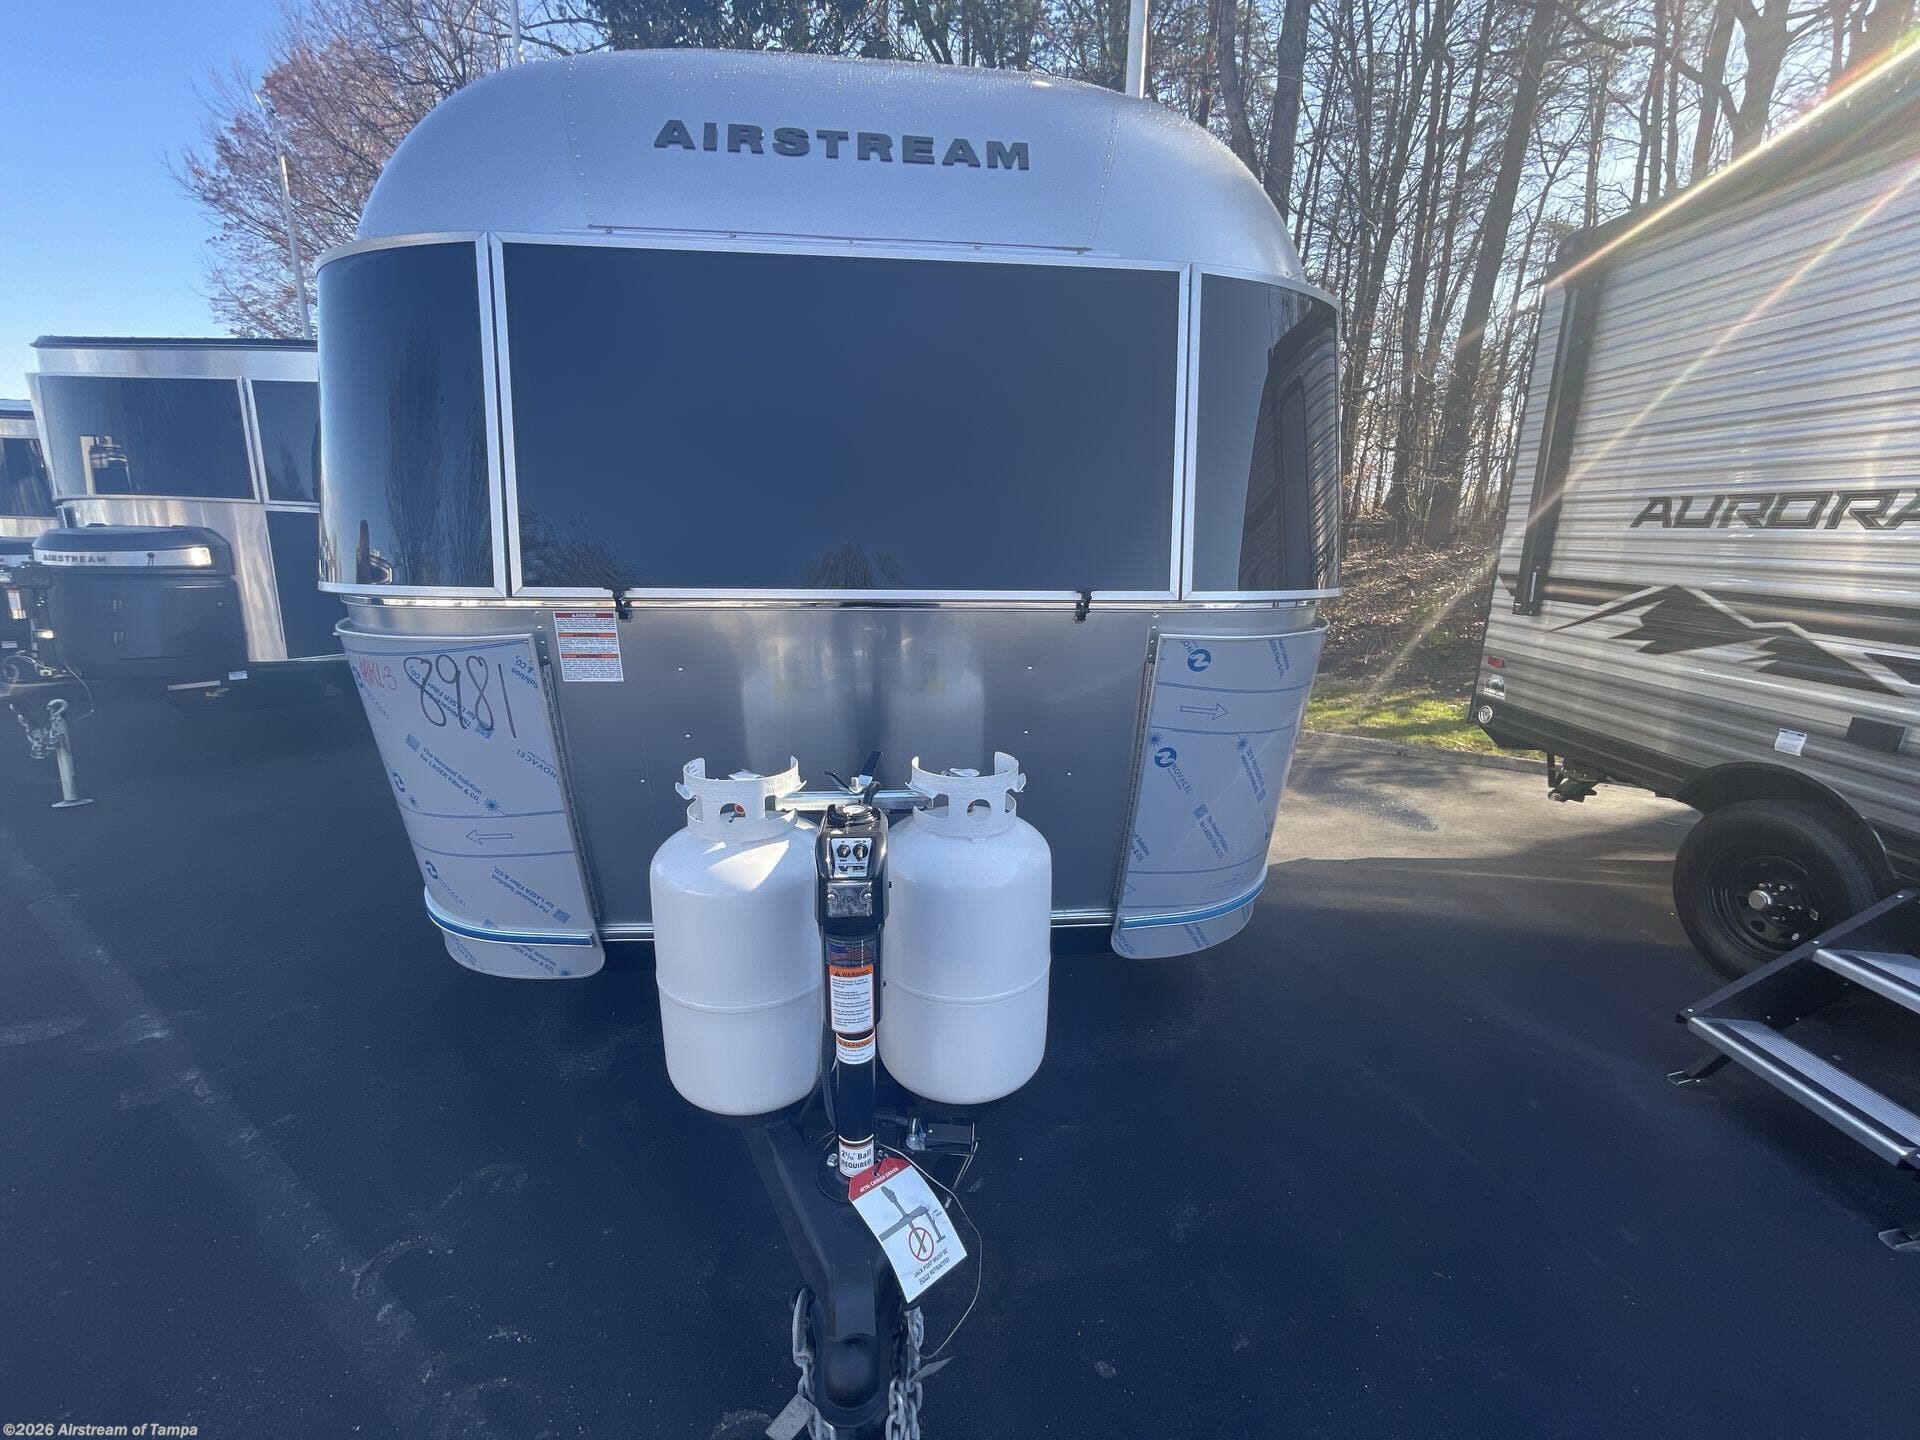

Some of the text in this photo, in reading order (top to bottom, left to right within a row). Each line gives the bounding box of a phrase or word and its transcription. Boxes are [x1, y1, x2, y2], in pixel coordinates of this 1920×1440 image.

[653, 119, 1030, 170] AIRSTREAM
[42, 554, 107, 563] AIRSTREAM
[403, 653, 518, 739] 8981
[516, 749, 557, 778] NOVACEL
[1171, 763, 1191, 794] NOVACEL
[842, 969, 869, 977] WARNING
[858, 1149, 872, 1160] Ball
